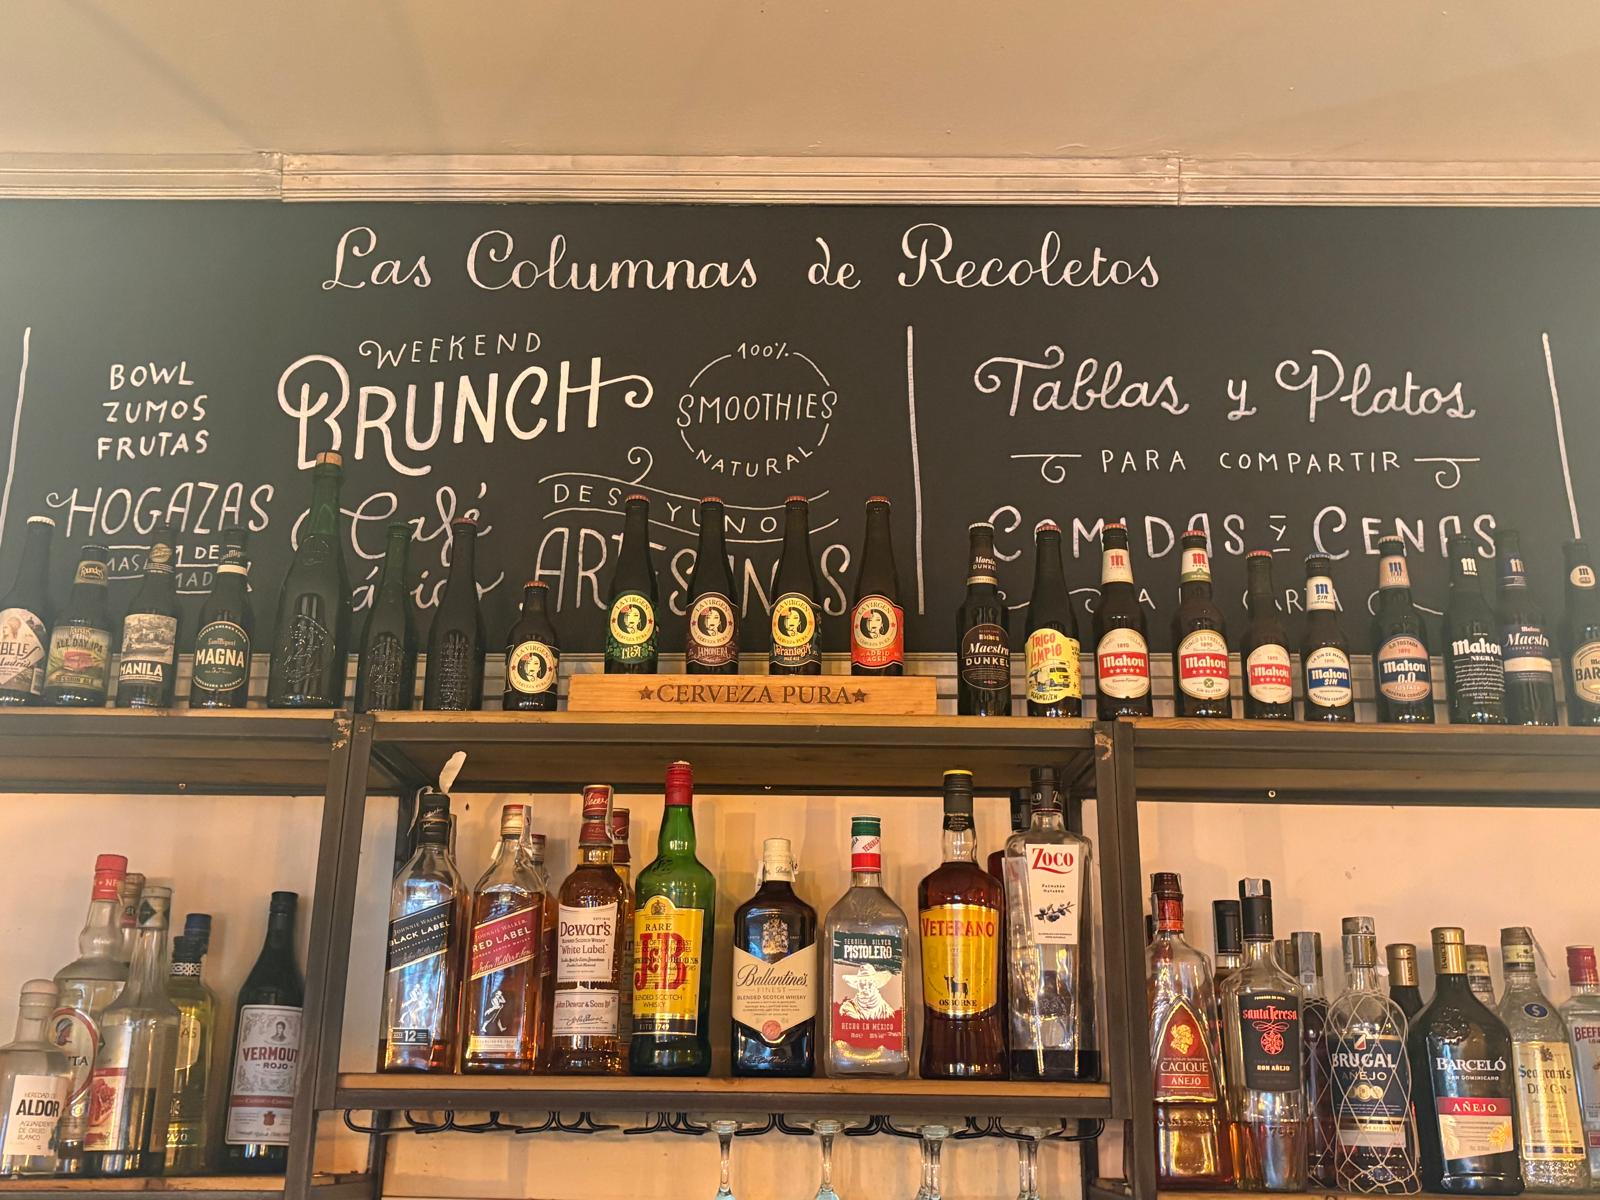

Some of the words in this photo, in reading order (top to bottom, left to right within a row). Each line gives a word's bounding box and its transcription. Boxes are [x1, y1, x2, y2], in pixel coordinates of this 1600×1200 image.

[322, 226, 432, 291] Las
[466, 230, 758, 292] Columnas
[807, 236, 861, 290] de
[897, 222, 1160, 288] Recoletos
[358, 331, 542, 370] WEEKEND
[736, 341, 790, 360] 100%
[109, 360, 195, 391] BOWL
[973, 344, 1190, 417] Tablas
[1227, 378, 1258, 421] y
[1274, 348, 1477, 423] Platos
[102, 394, 209, 424] ZUMOS
[277, 354, 655, 477] BRUNCH
[676, 390, 838, 428] SMOOTHIES
[97, 429, 210, 462] FRUTAS
[695, 446, 814, 478] NATURAL
[1101, 448, 1187, 474] PARA
[1219, 451, 1401, 475] COMPARTIR
[45, 481, 275, 538] HOGAZAS
[986, 504, 1246, 561] CMDAS
[194, 544, 220, 560] DE
[0, 641, 41, 661] BELES
[195, 647, 245, 668] MAGNA
[965, 658, 1010, 668] DUNKEL
[1103, 654, 1145, 669] Mahou
[1185, 655, 1227, 669] Mahou
[1383, 659, 1427, 674] Mahou
[120, 663, 163, 677] MANILA
[1254, 666, 1290, 679] Mahou
[1311, 668, 1348, 680] Mahou
[1575, 667, 1600, 681] BAR
[1324, 678, 1338, 686] SIN
[655, 683, 774, 705] CERVEZA
[780, 684, 853, 706] PURA
[420, 920, 451, 936] LABEL
[560, 921, 611, 937] Dewar's
[645, 922, 672, 932] RARE
[921, 917, 995, 938] VETERANO
[472, 939, 493, 953] RED
[496, 926, 532, 944] LABEL
[843, 944, 893, 960] PISTOLERO
[735, 963, 808, 988] Ballantine's
[565, 999, 585, 1009] Dewar
[938, 999, 978, 1008] OSBORNE
[1532, 1005, 1541, 1016] S
[404, 1030, 417, 1042] 12
[263, 1062, 289, 1070] ROJO
[1160, 1061, 1209, 1073] CACIQUE
[1271, 1064, 1290, 1072] AÑEJO
[1331, 1053, 1396, 1068] BRUGAL
[1436, 1056, 1507, 1072] BARCELÓ
[1518, 1064, 1572, 1080] Searam's
[1171, 1075, 1202, 1086] AÑEJO
[15, 1098, 60, 1118] ALDOR
[1452, 1101, 1497, 1113] AÑEJO
